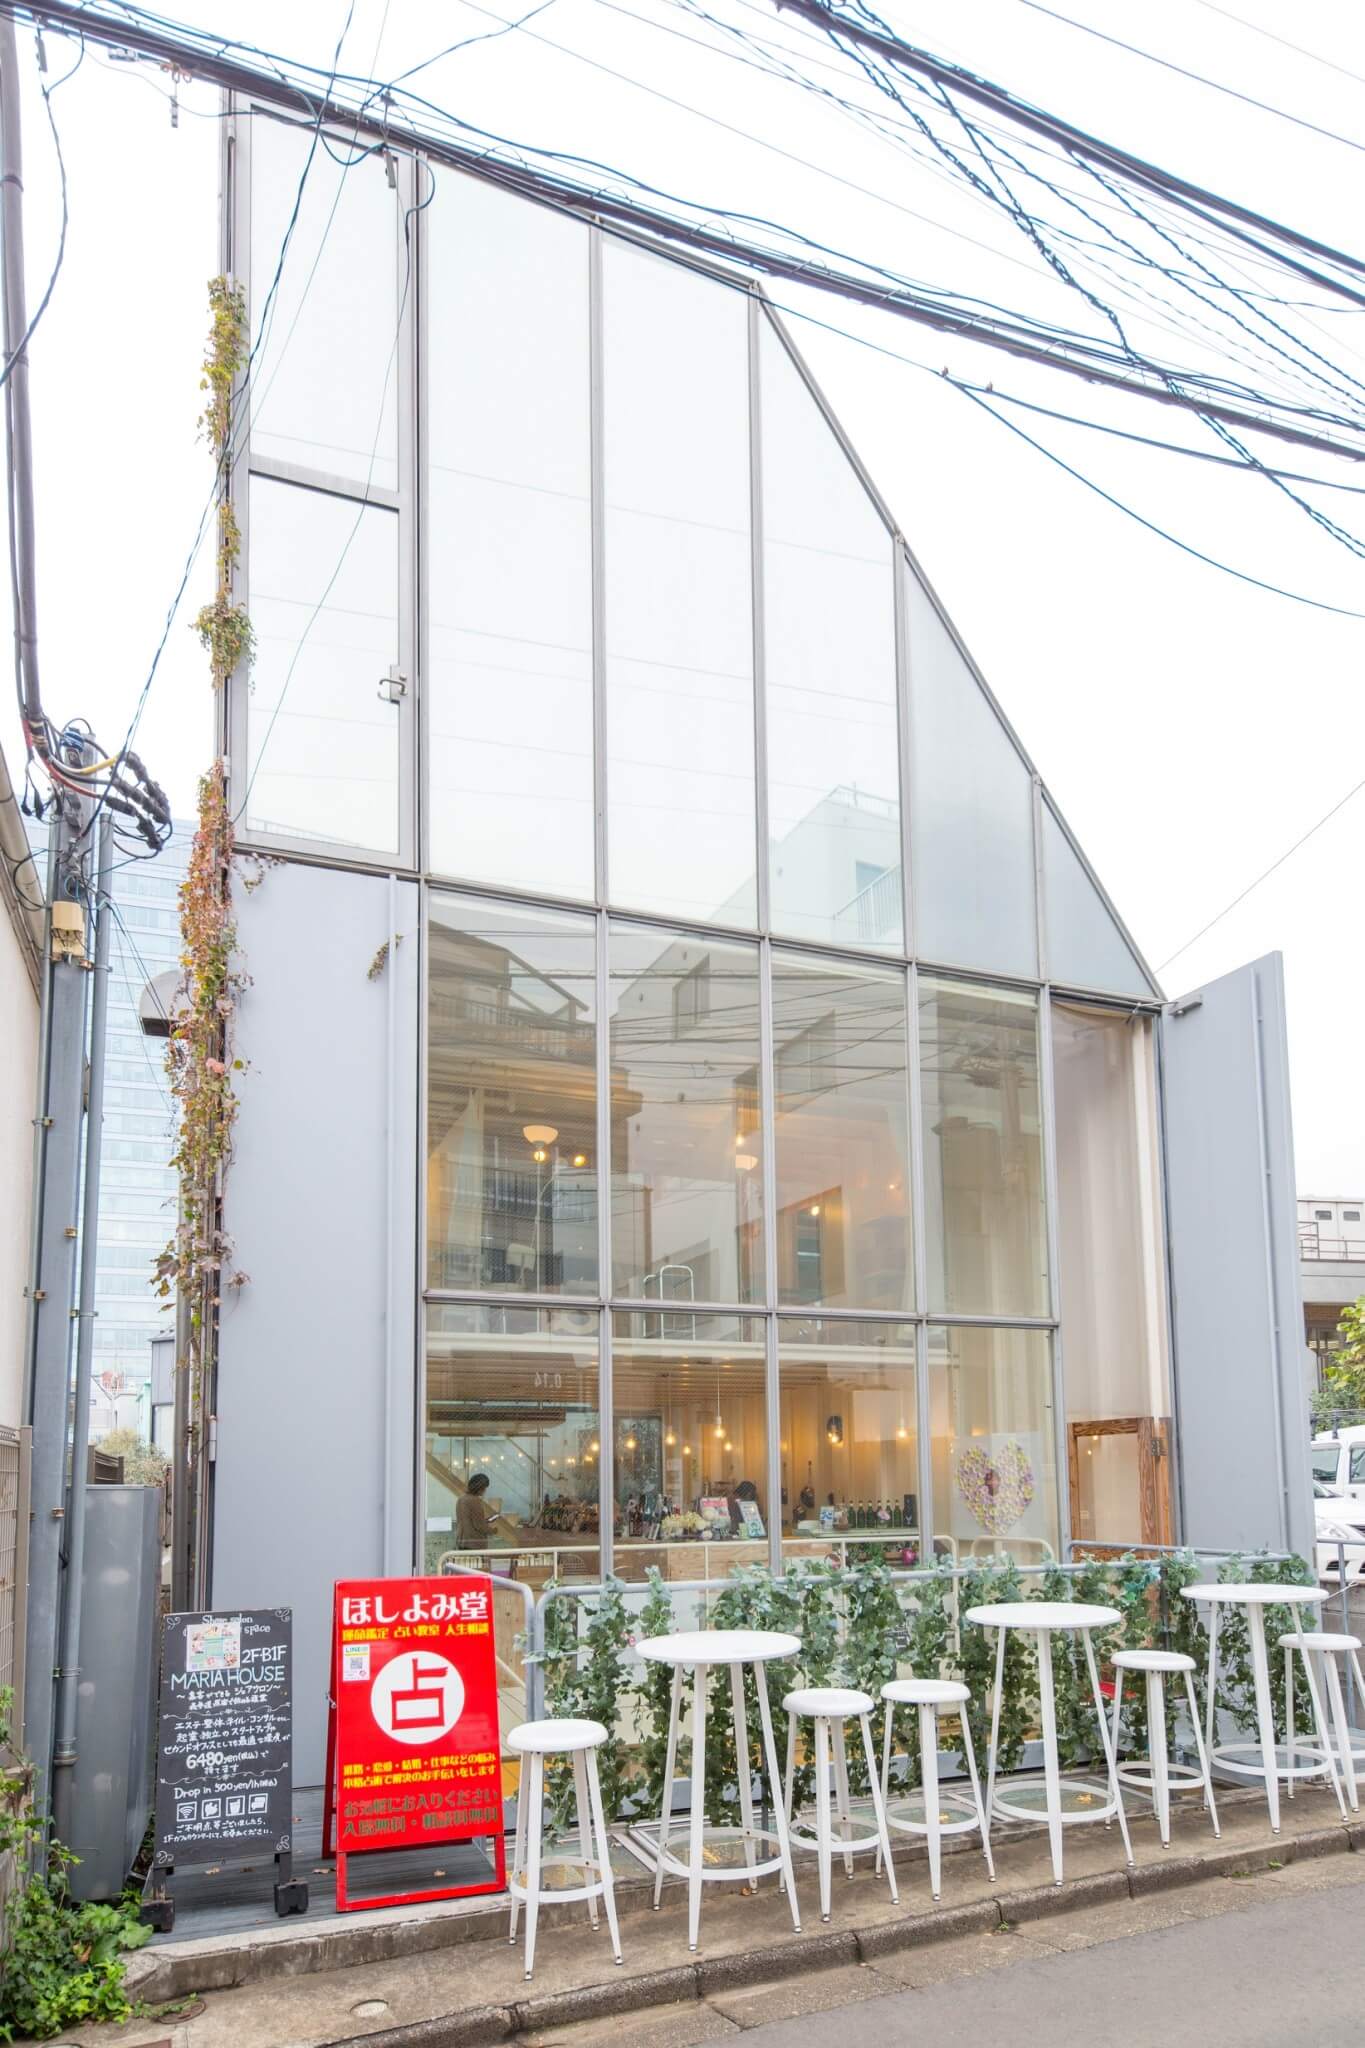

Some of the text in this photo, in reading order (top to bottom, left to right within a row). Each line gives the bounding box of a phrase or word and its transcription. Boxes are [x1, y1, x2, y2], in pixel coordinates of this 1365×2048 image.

[342, 1591, 489, 1625] ほしよみ堂
[244, 1625, 271, 1636] space
[171, 1665, 286, 1691] MARIA HOUSE
[390, 1657, 448, 1731] 占
[174, 1787, 200, 1800] Drop
